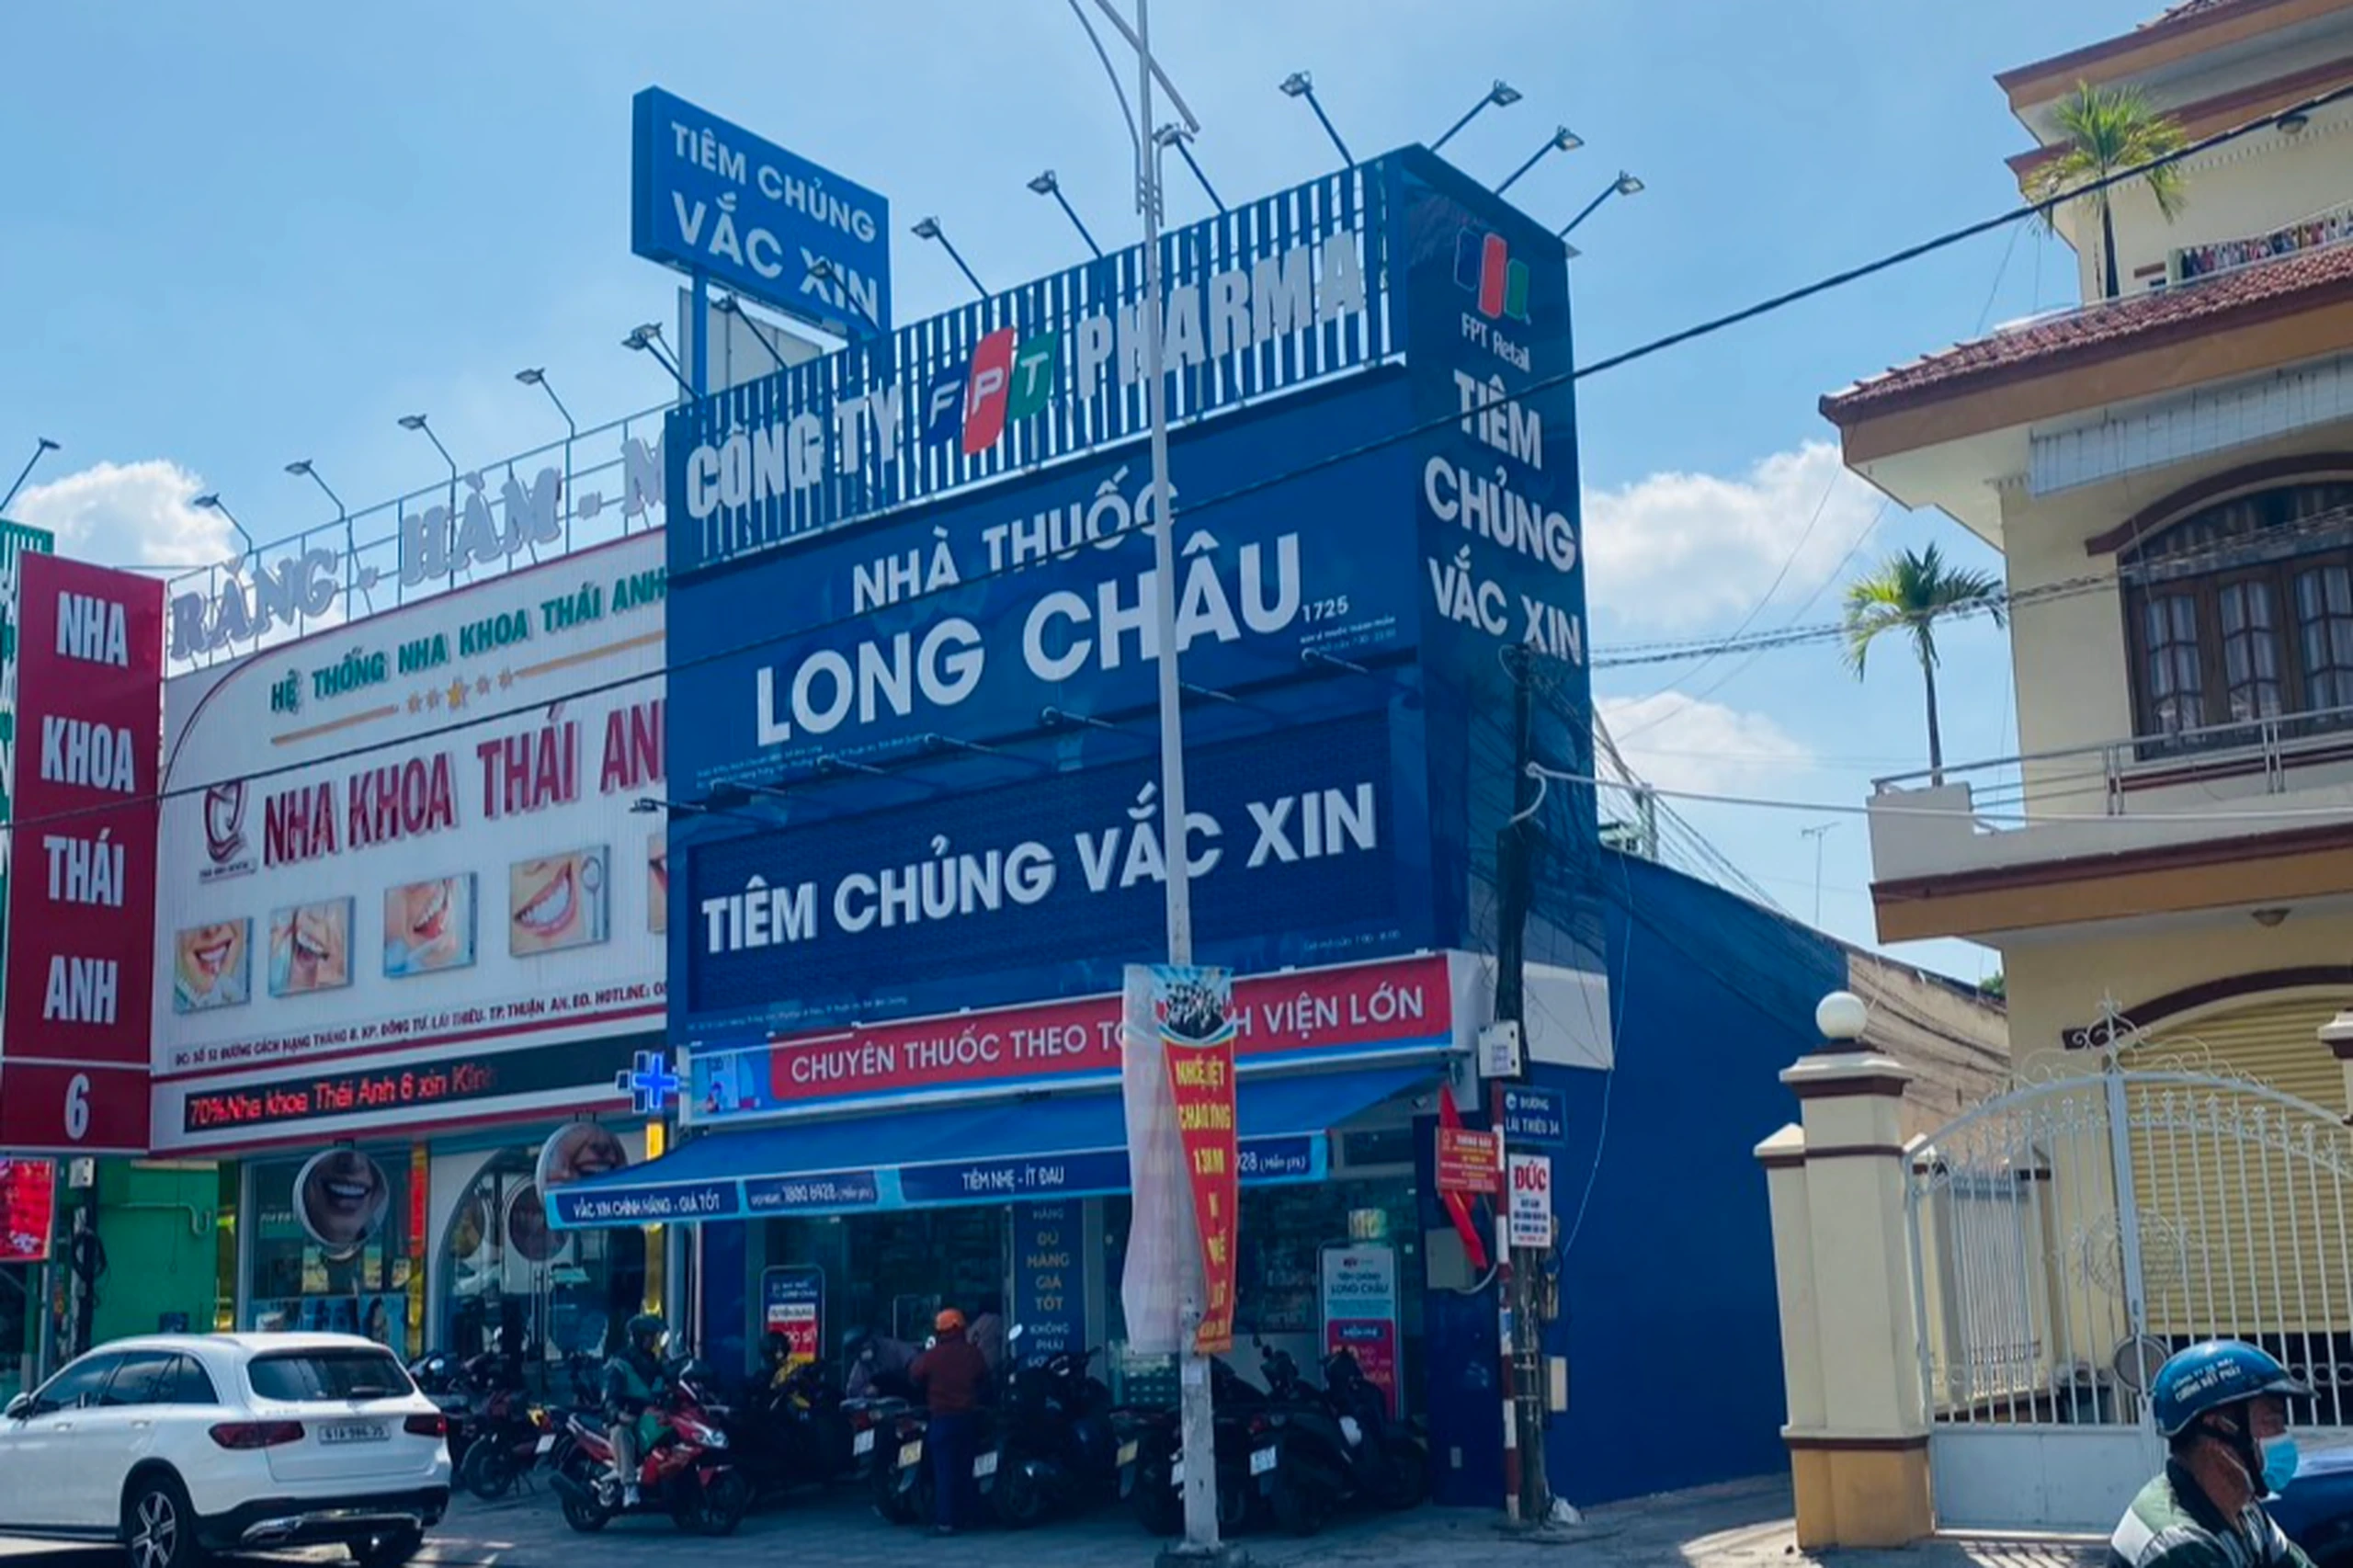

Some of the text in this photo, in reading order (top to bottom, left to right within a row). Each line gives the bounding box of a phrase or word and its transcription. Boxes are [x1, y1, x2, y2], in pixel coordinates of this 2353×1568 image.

[672, 120, 876, 243] TIÊM CHỦNG
[672, 189, 879, 328] VẮC XIN
[686, 411, 824, 519] CÔNG
[836, 382, 902, 474] TY
[1076, 230, 1367, 401] PHARMA
[1461, 312, 1530, 373] FPT Retail
[1454, 369, 1541, 471] TIÊM
[853, 466, 1180, 613] NHÀ THUỐC
[1425, 456, 1576, 573] CHỦNG
[171, 548, 342, 660] RĂNG
[401, 467, 564, 586] HÀM
[57, 591, 129, 669] NHA
[271, 568, 666, 714] HỆ THỐNG NHA KHOA THÁI ANH
[756, 528, 1302, 747] LONG CHÂU
[1302, 595, 1349, 624] 1725
[1427, 543, 1582, 666] VẮC XIN
[41, 715, 135, 794] KHOA
[264, 699, 666, 868] NHA KHOA THÁI AN
[44, 827, 125, 907] THÁI
[701, 781, 1379, 955] TIÊM CHỦNG VẮC XIN
[43, 955, 119, 1025] ANH
[791, 1040, 894, 1084] CHUYÊN
[904, 1024, 1000, 1070] THUỐC
[1010, 1025, 1087, 1060] THEO
[1264, 993, 1338, 1040] VIỆN
[1350, 981, 1424, 1025] LỚN
[64, 1074, 90, 1141] 6
[358, 1075, 395, 1105] Anh
[400, 1073, 414, 1100] 6
[699, 1187, 721, 1210] TỐT
[961, 1167, 990, 1191] TIÊM
[1039, 1166, 1064, 1187] ĐAU
[1514, 1159, 1547, 1192] ĐỨC
[1026, 1250, 1071, 1269] HÀNG
[1035, 1272, 1063, 1290] GIÁ
[1035, 1294, 1064, 1312] TỐT
